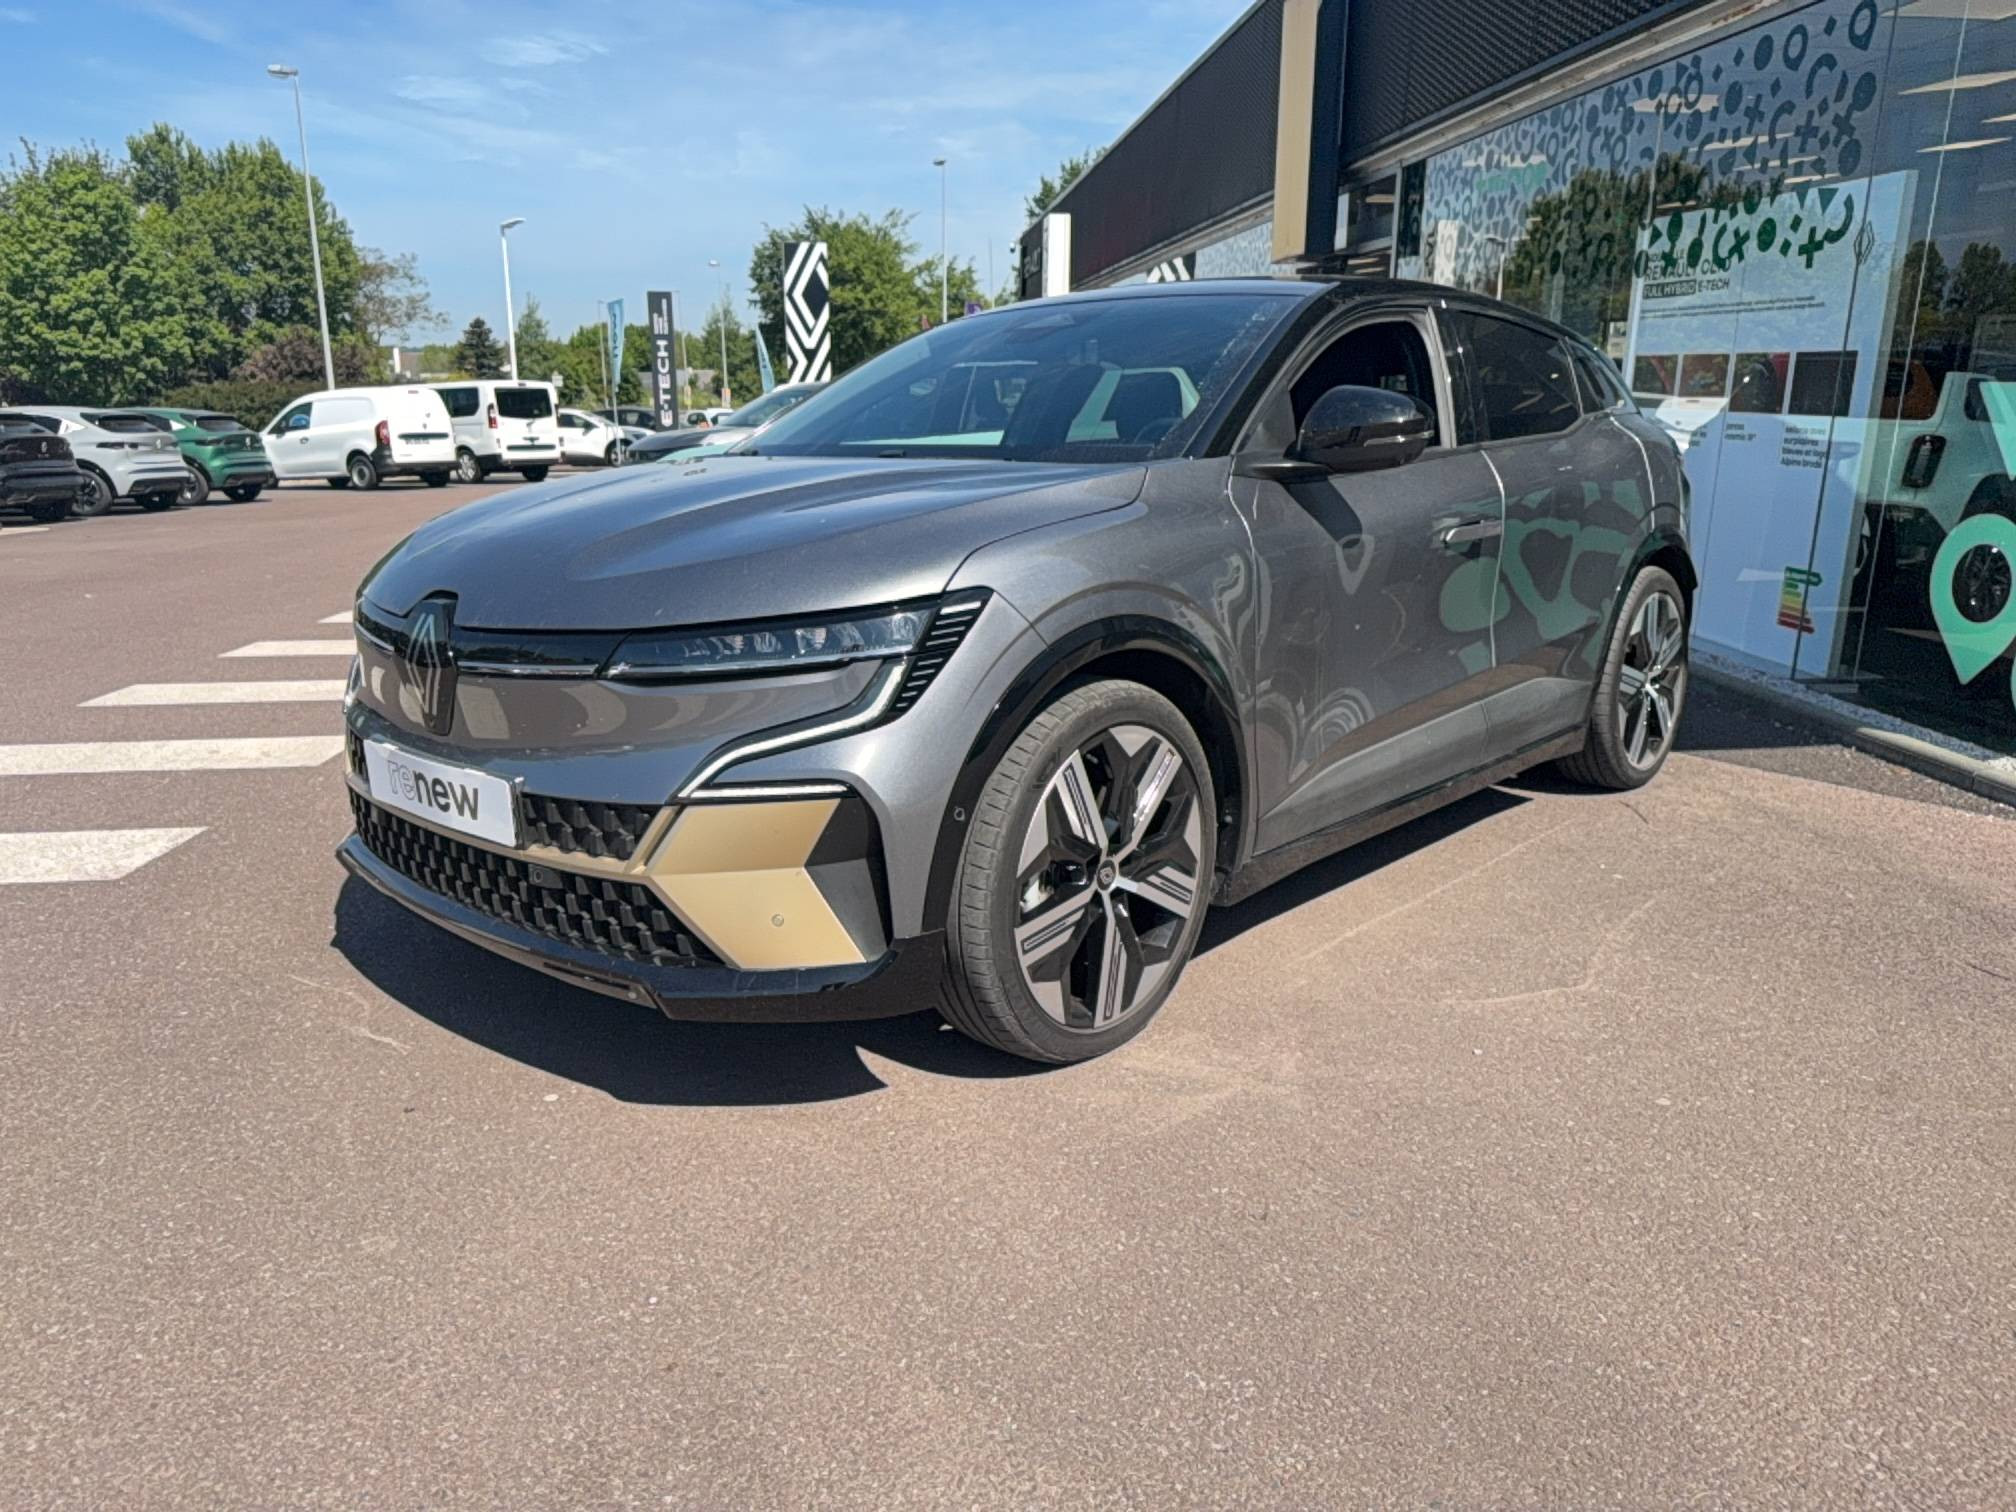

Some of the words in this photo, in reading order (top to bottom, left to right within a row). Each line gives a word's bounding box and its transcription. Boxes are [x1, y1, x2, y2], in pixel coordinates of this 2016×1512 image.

[1701, 256, 1732, 276] CLO
[1644, 284, 1663, 298] FULL
[1698, 278, 1730, 293] E-TECH
[656, 339, 674, 428] E-TECH
[387, 760, 479, 821] renew
